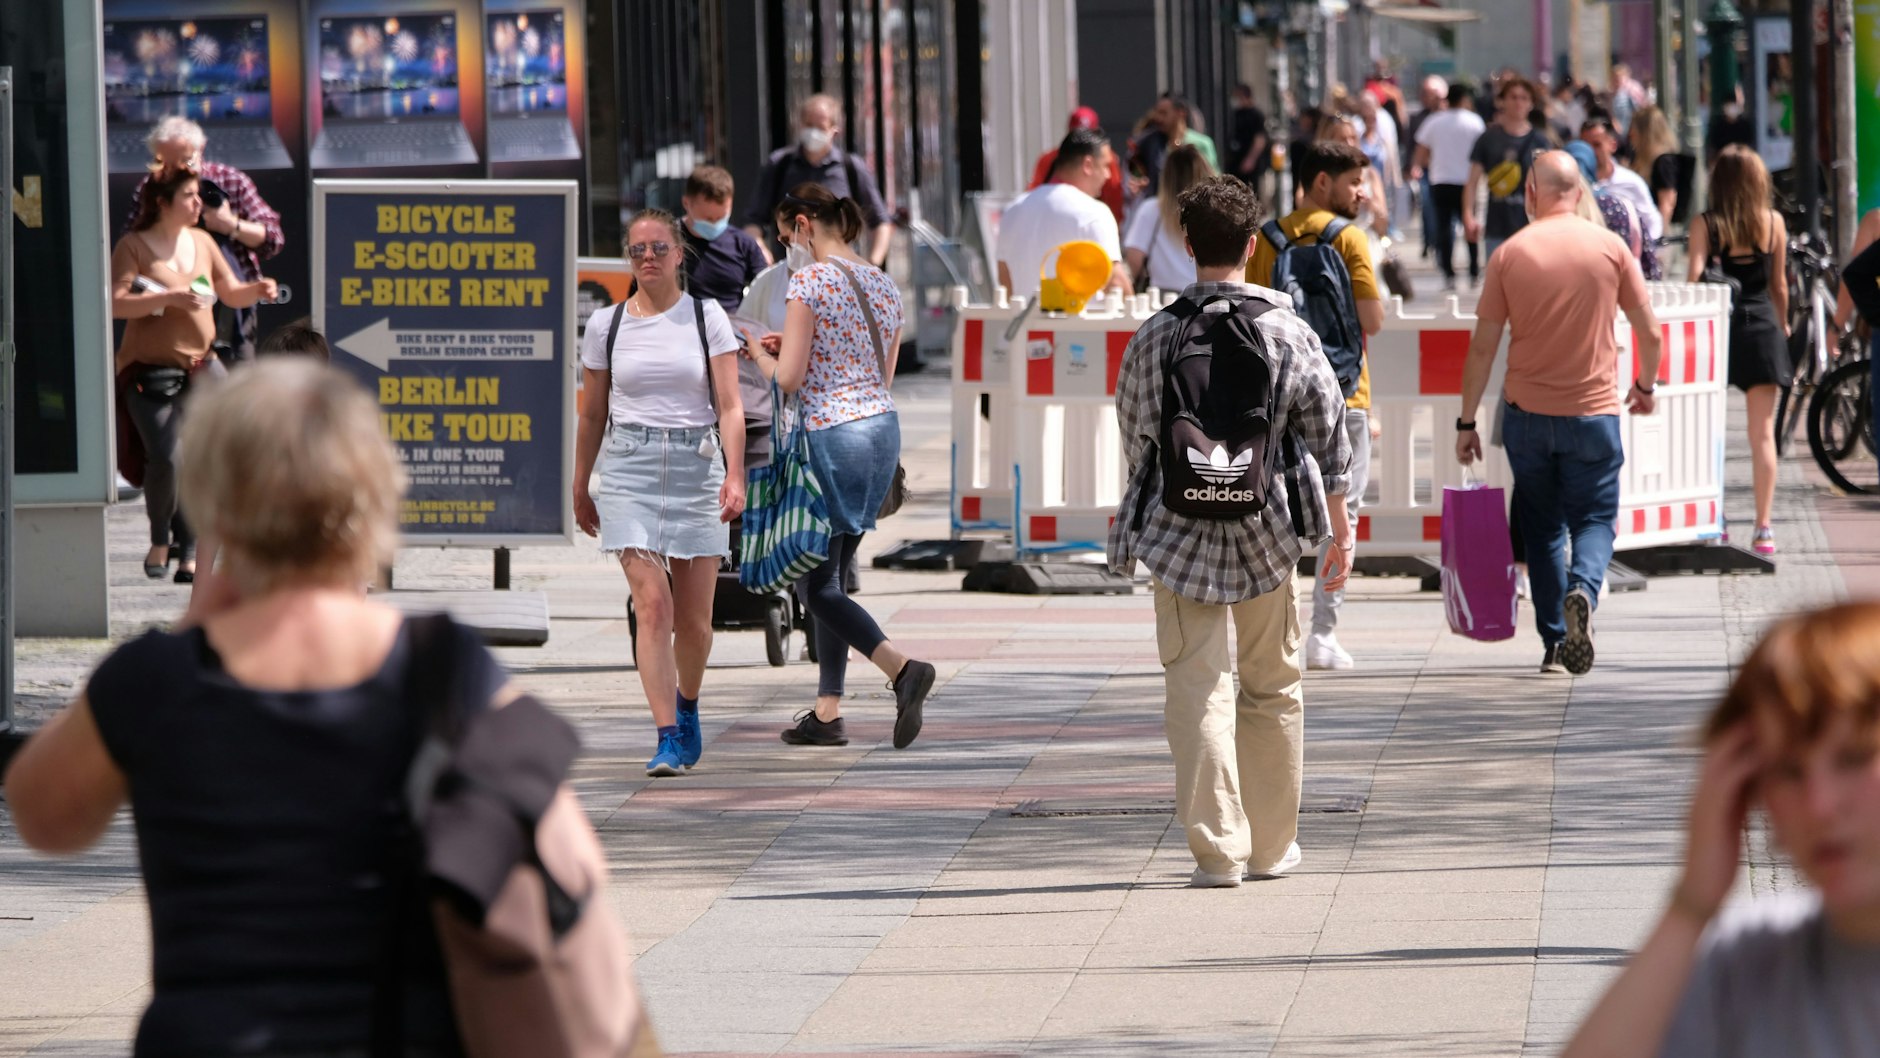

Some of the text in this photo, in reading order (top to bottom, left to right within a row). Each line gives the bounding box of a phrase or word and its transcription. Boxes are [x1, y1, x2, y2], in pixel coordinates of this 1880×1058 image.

[377, 205, 516, 234] BICYCLE
[354, 241, 536, 270] E-SCOOTER
[340, 278, 451, 306] E-BIKE
[460, 278, 549, 306] RENT
[395, 334, 422, 345] BIKE
[426, 334, 456, 345] RENT
[470, 334, 496, 345] BIKE
[498, 334, 535, 345] TOURS
[400, 346, 534, 357] BERLIN EUROPA CENTER
[379, 377, 499, 404] BERLIN
[379, 413, 531, 442] IKE TOUR
[413, 448, 429, 462] IN
[432, 448, 462, 462] ONE
[465, 448, 504, 462] TOUR
[449, 465, 460, 475] IN
[463, 465, 500, 475] BERLIN
[1184, 486, 1254, 501] adidas
